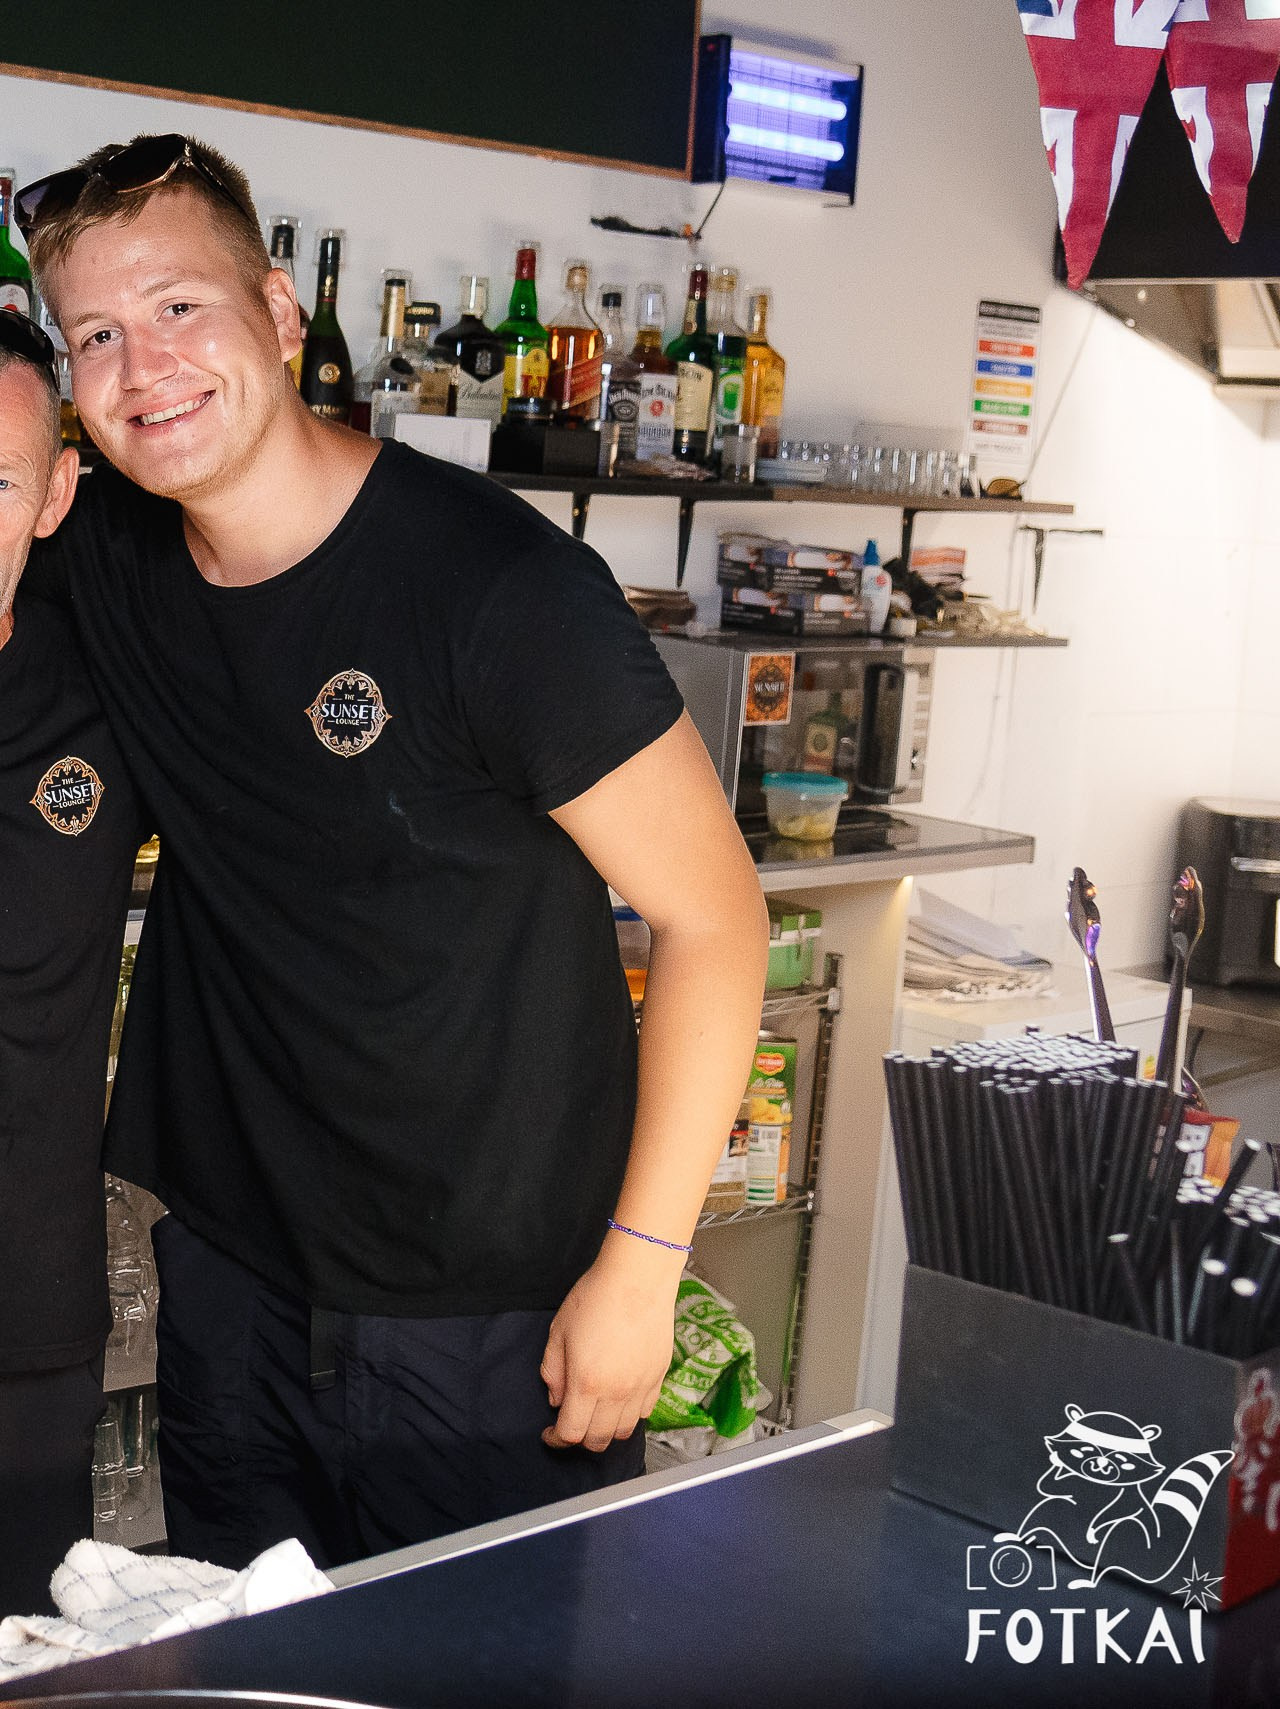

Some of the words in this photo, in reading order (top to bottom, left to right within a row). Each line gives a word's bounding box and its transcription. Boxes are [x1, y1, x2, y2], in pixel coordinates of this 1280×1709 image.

[344, 693, 355, 701] THE
[320, 703, 378, 720] SUNSET
[335, 718, 360, 726] LOUNGE
[61, 777, 75, 786] THE
[43, 782, 97, 805] SUNSET
[58, 797, 86, 809] LOUNGE
